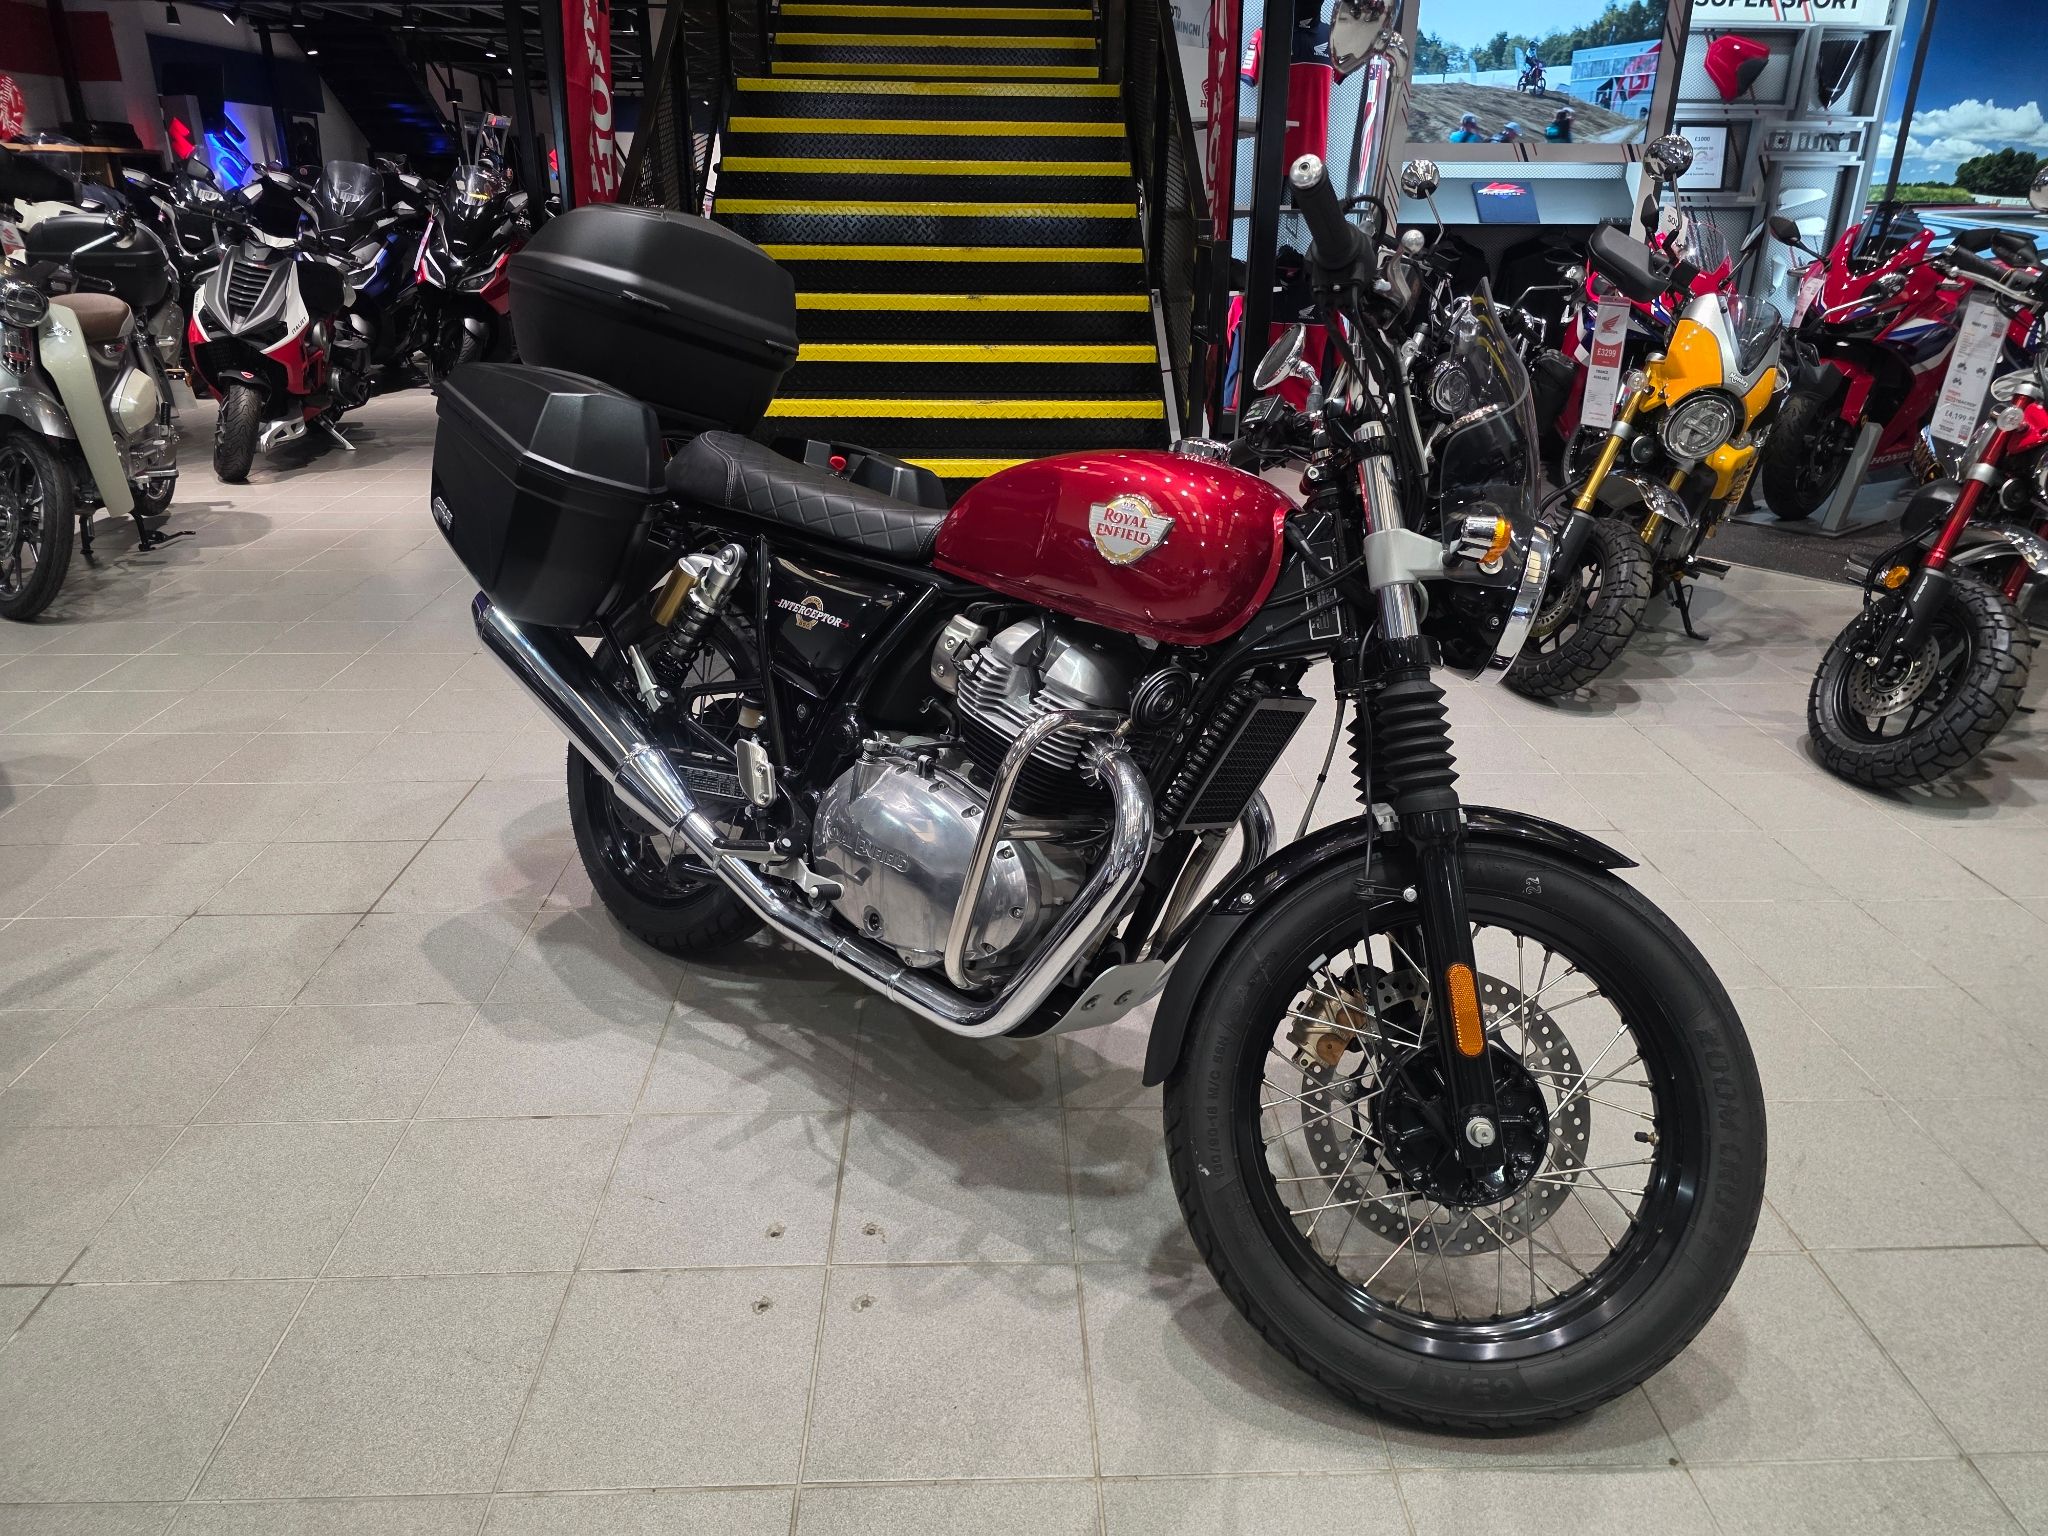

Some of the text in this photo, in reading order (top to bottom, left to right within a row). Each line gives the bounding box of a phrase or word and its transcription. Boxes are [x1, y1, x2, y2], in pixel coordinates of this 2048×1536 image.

[1597, 348, 1617, 358] £3299
[1104, 507, 1149, 529] ROYAL
[1096, 522, 1152, 546] ENFIELD
[778, 598, 843, 628] INTERCEPTOR
[1206, 1070, 1221, 1100] M/C
